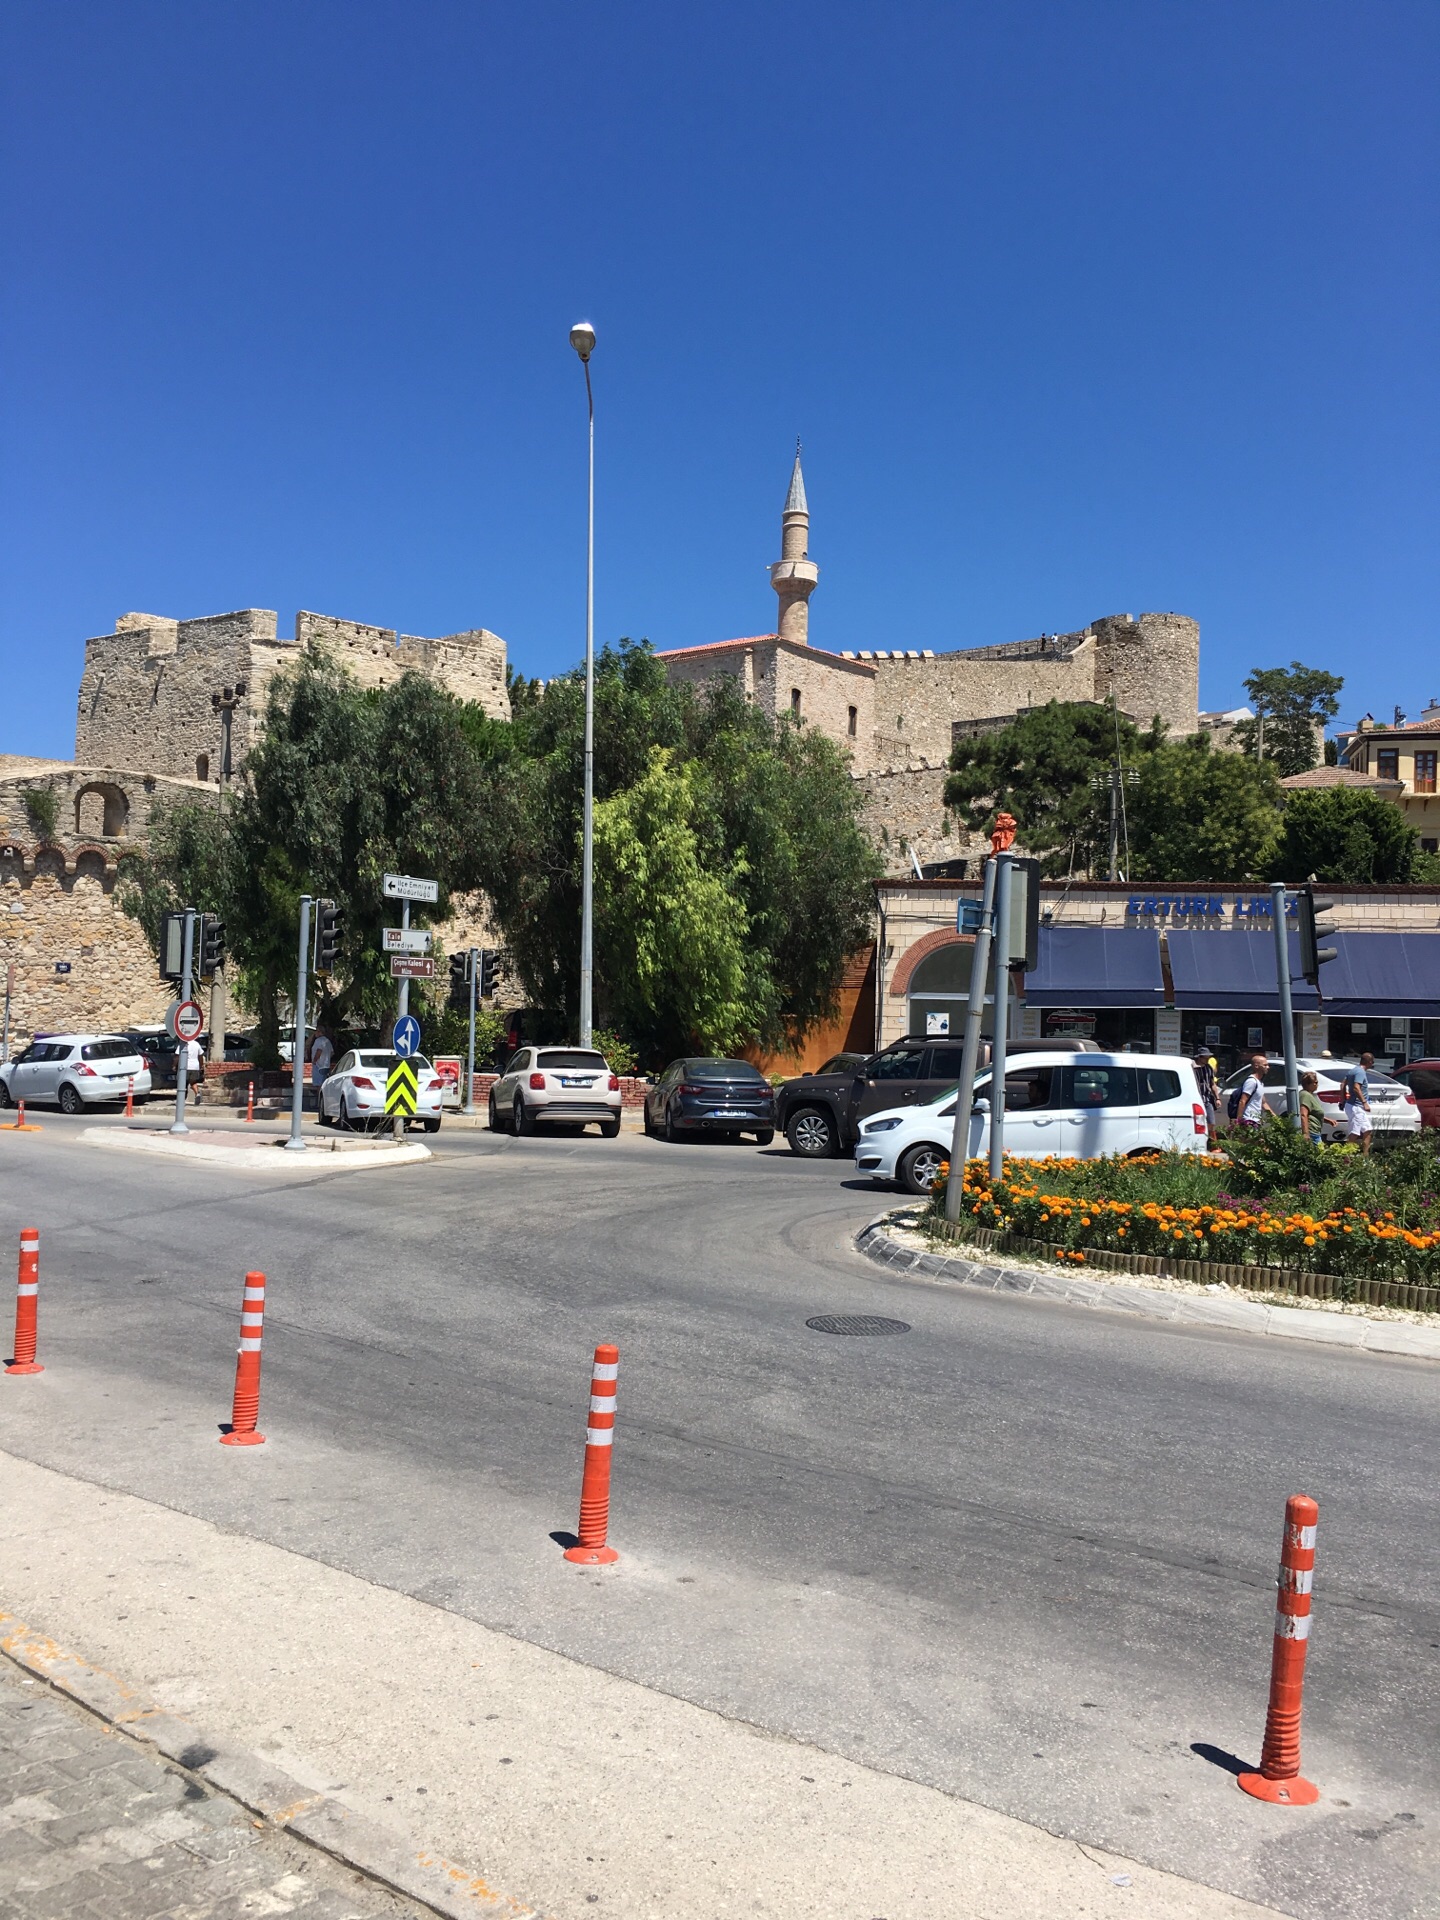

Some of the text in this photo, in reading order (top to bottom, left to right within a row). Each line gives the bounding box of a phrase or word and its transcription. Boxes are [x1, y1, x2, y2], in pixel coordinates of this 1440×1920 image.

[409, 881, 434, 891] Emniyet
[388, 941, 414, 951] Belediye
[408, 960, 424, 968] Kalesi
